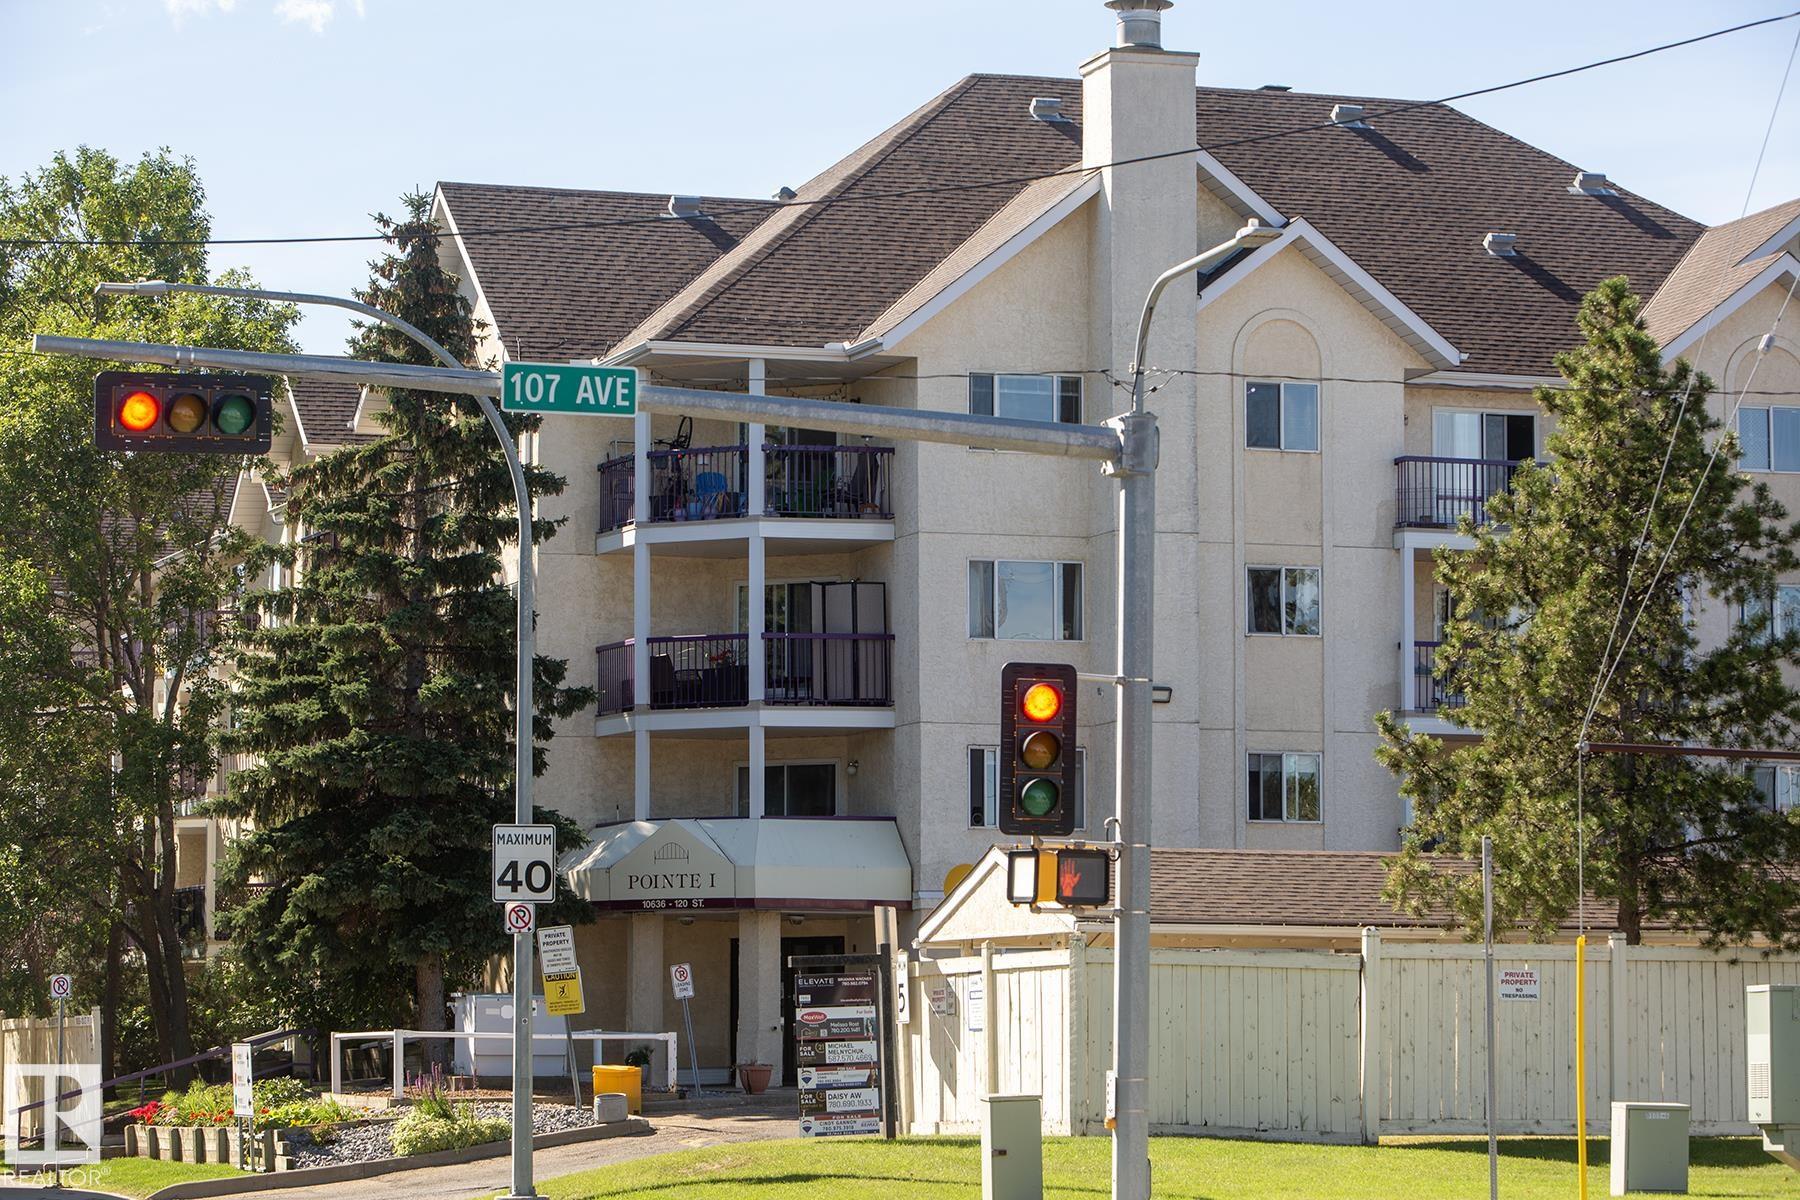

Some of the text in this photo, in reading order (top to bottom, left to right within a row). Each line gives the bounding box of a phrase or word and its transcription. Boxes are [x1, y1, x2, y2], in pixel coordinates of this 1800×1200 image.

[510, 372, 630, 406] 107 AVE
[497, 833, 552, 845] MAXIMUM
[497, 860, 552, 893] 40
[628, 873, 716, 889] POINTE I
[642, 900, 666, 908] 10636
[674, 900, 688, 908] 120
[692, 899, 704, 908] ST.
[542, 939, 569, 947] PROPERTY
[546, 973, 576, 981] CAUTION
[828, 1100, 873, 1108] 780.690.1933
